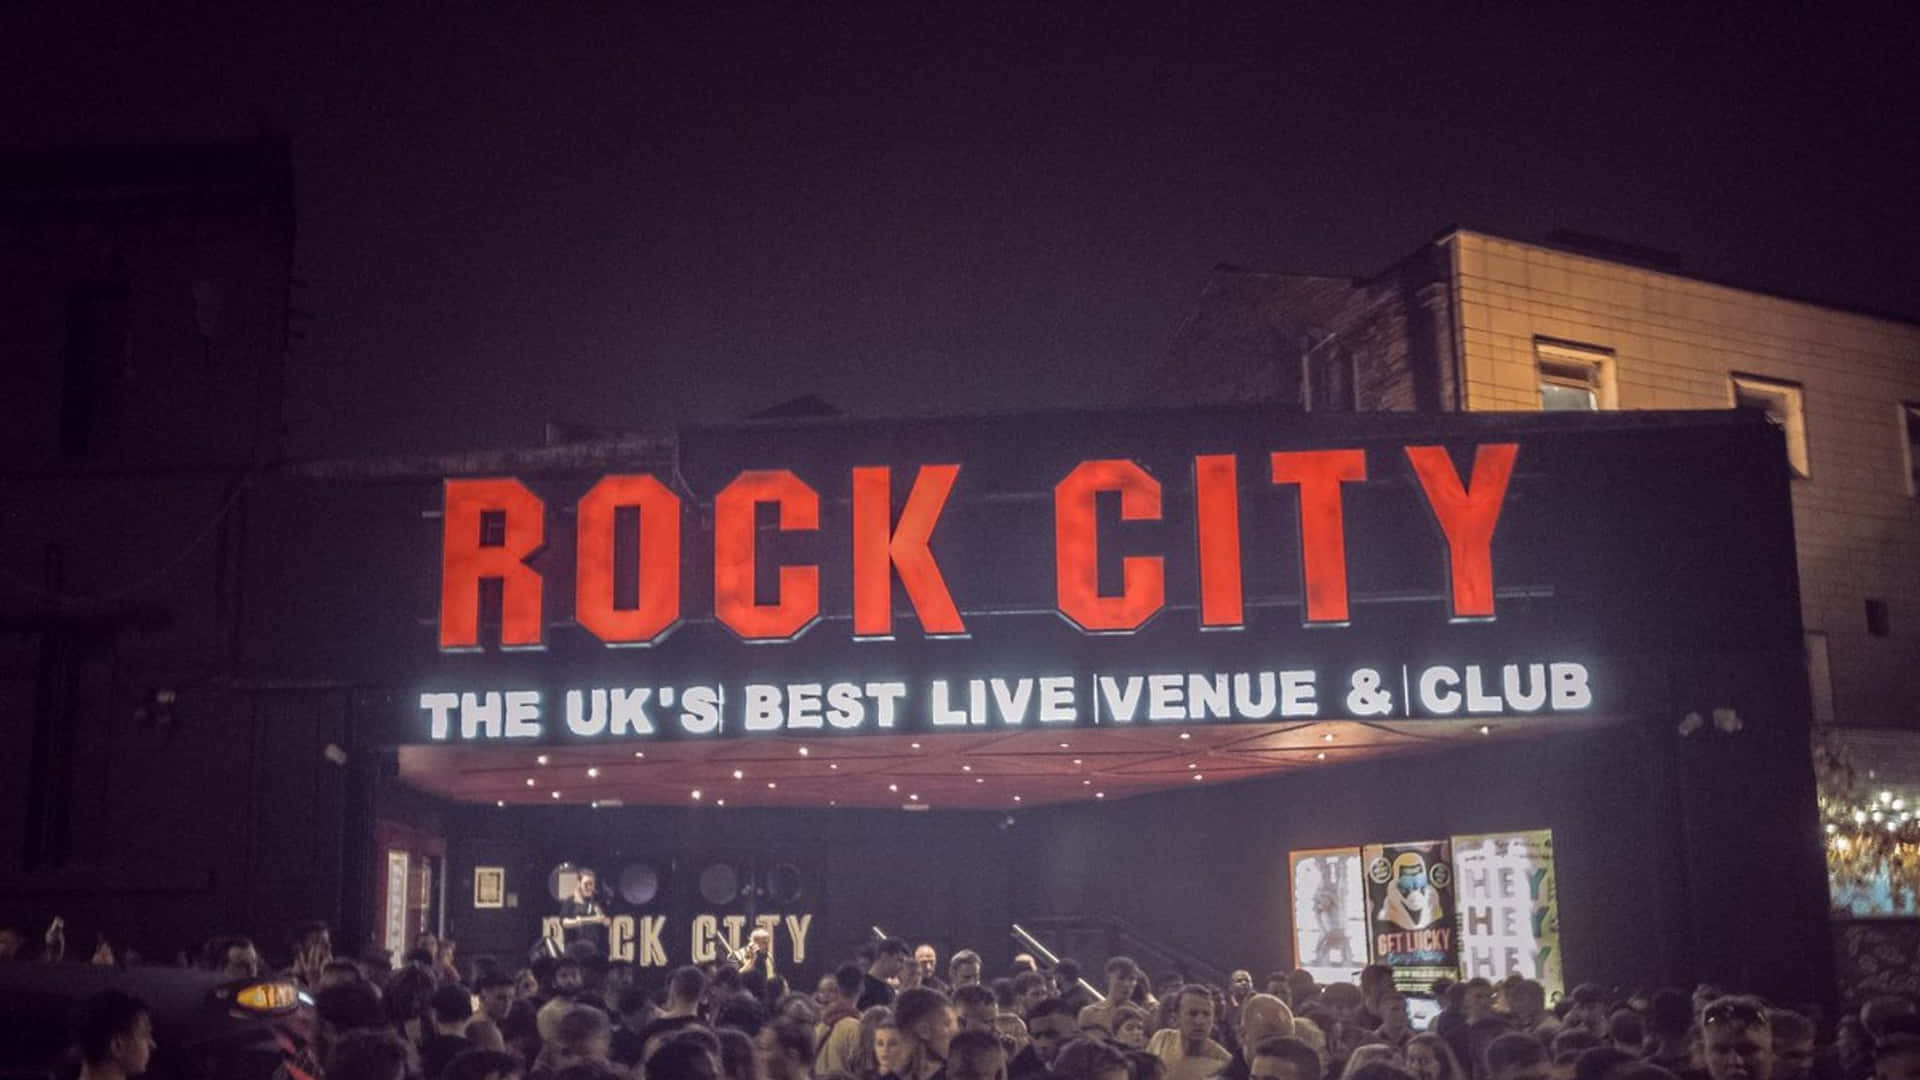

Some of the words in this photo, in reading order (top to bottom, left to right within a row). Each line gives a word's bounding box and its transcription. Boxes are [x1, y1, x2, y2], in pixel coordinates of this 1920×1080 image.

[438, 463, 970, 652] ROCK
[1054, 443, 1520, 636] CITY
[420, 690, 542, 739] THE
[565, 686, 720, 737] UK'S
[744, 682, 907, 731] BEST
[931, 676, 1078, 725] LIVE
[1099, 670, 1319, 722] VENUE
[1345, 668, 1393, 716] &
[1419, 662, 1592, 714] CLUB
[1464, 868, 1547, 900] HEY
[1467, 906, 1550, 938] HEY
[1377, 932, 1403, 956] GET
[1405, 927, 1452, 953] LUCKY
[1470, 945, 1553, 981] HEY
